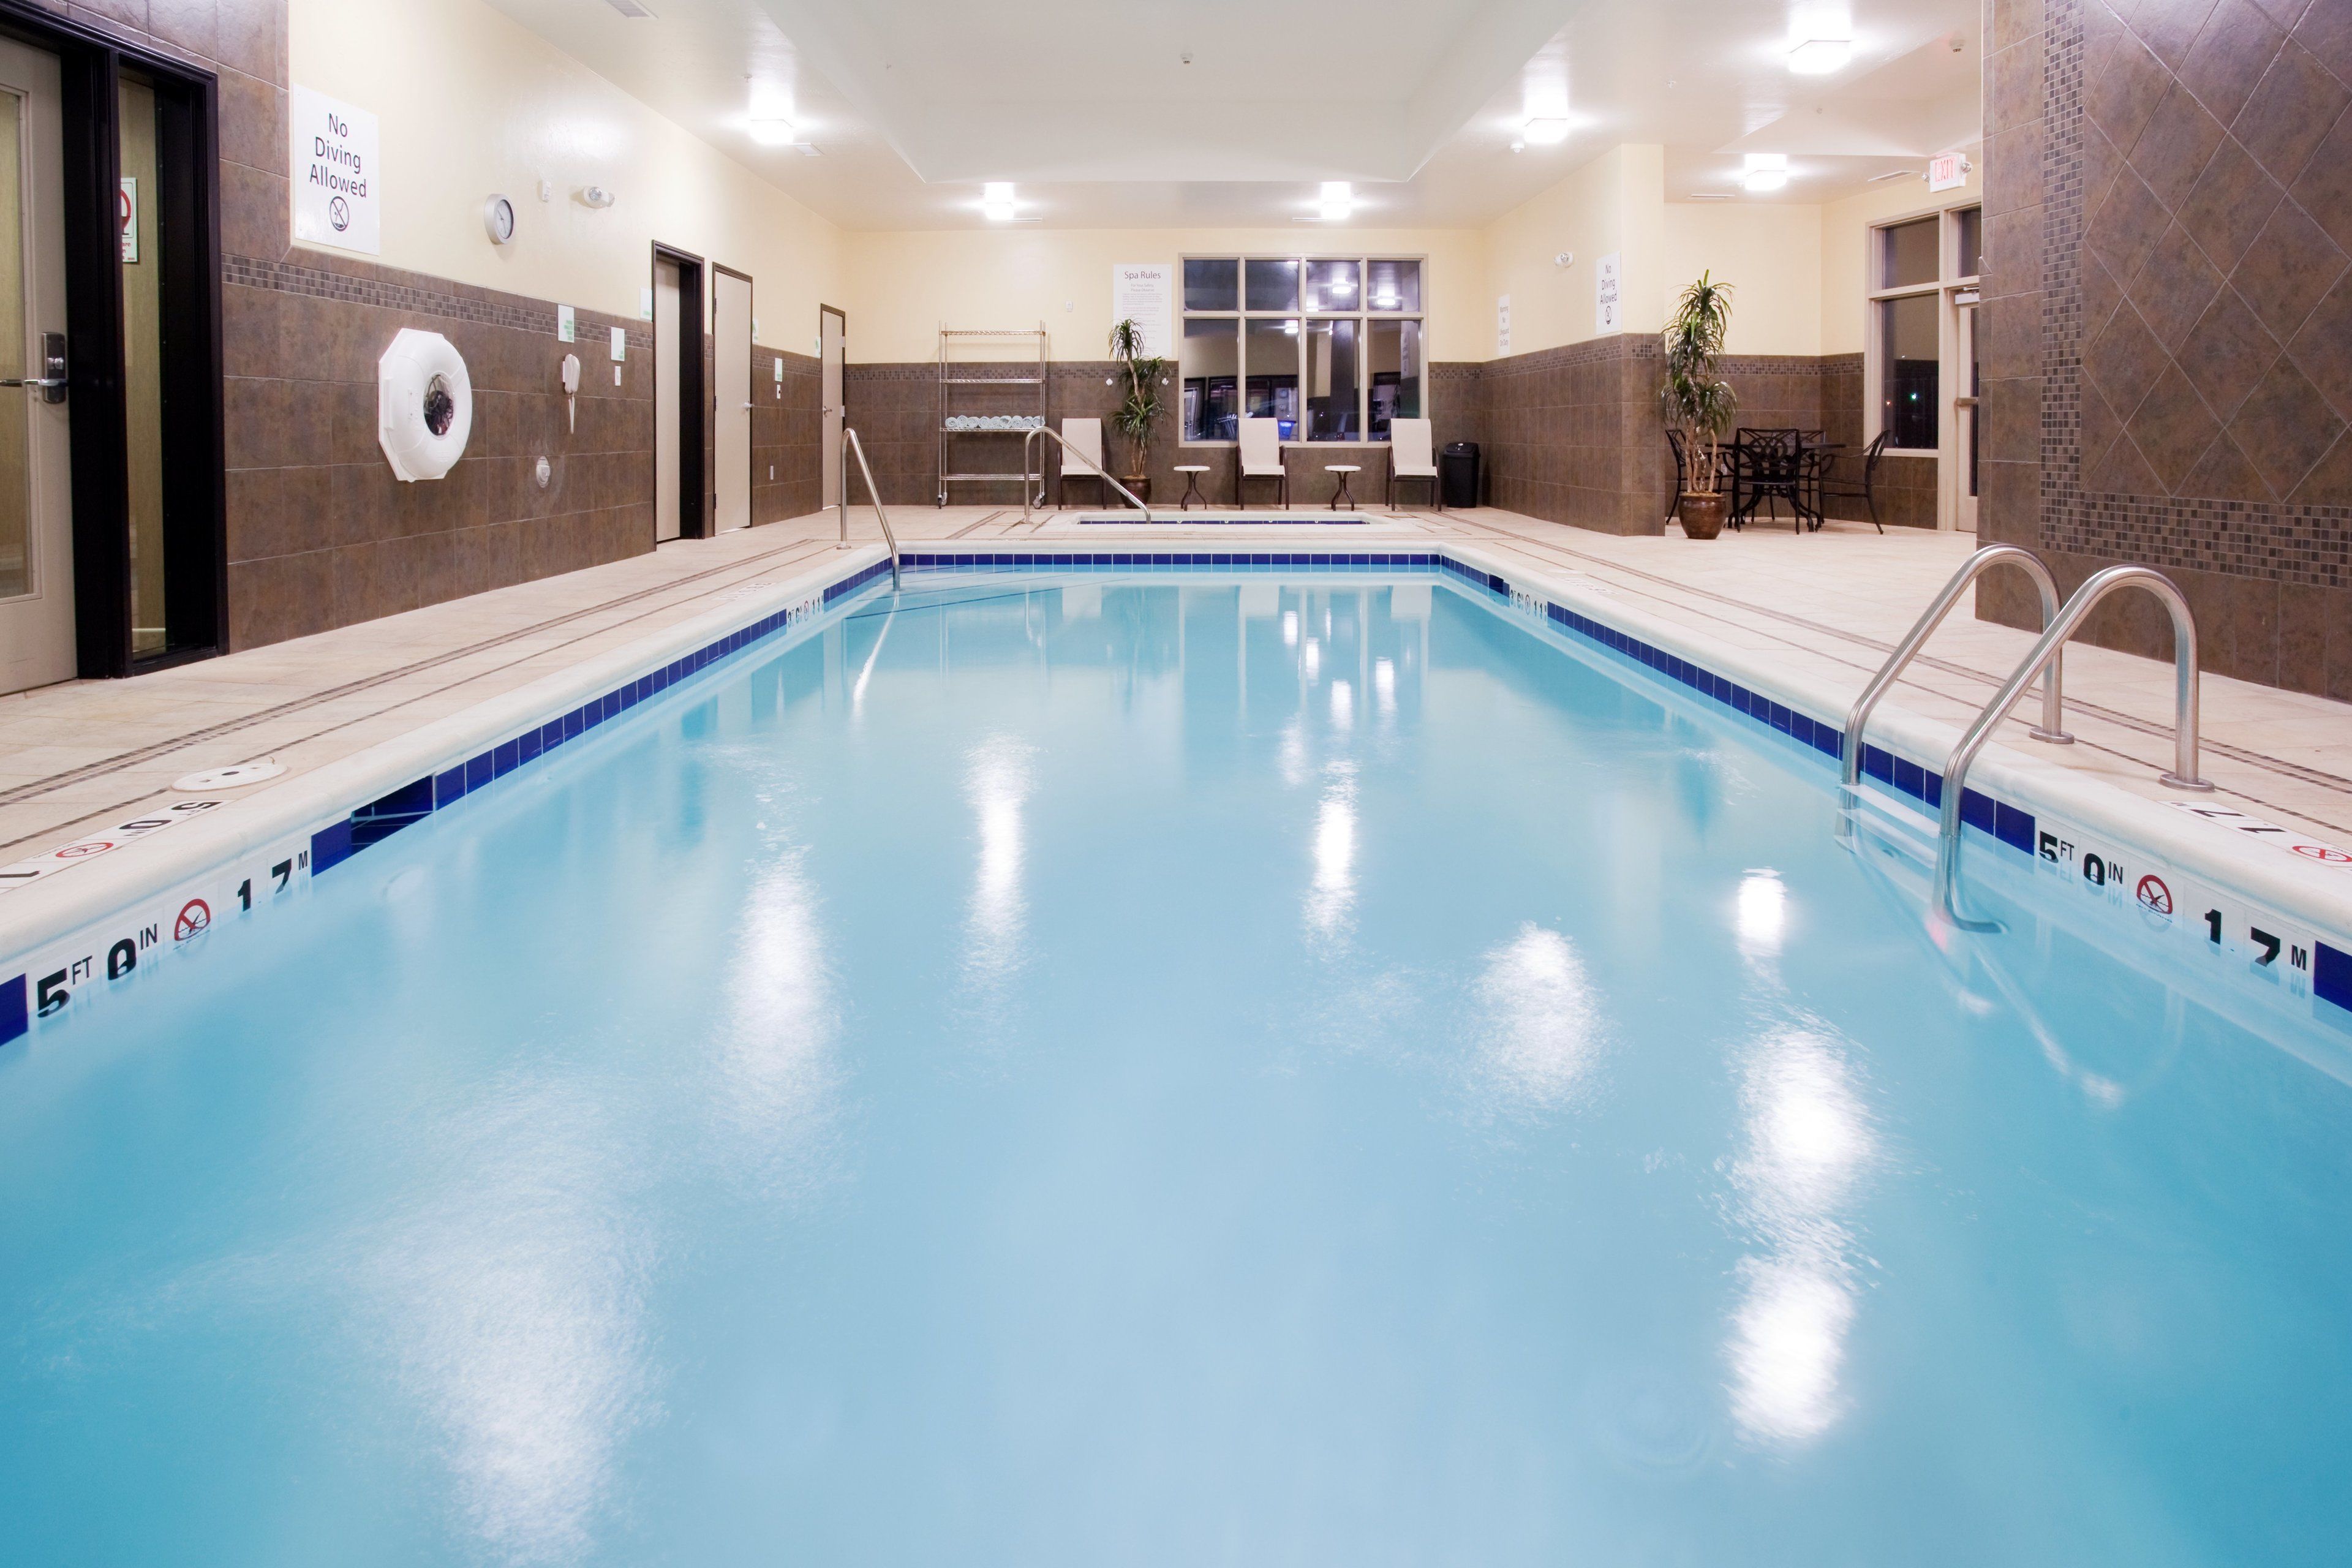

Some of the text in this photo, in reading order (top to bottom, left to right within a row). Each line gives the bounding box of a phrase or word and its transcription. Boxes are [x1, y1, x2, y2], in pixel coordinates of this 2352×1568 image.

[329, 113, 348, 138] No
[315, 136, 361, 175] Diving
[1935, 158, 1956, 182] EXIT
[309, 164, 367, 198] Allowed
[1125, 271, 1161, 281] Spa Rules
[1605, 264, 1611, 274] No
[1601, 277, 1615, 290] Diving
[1600, 290, 1617, 305] Allowed
